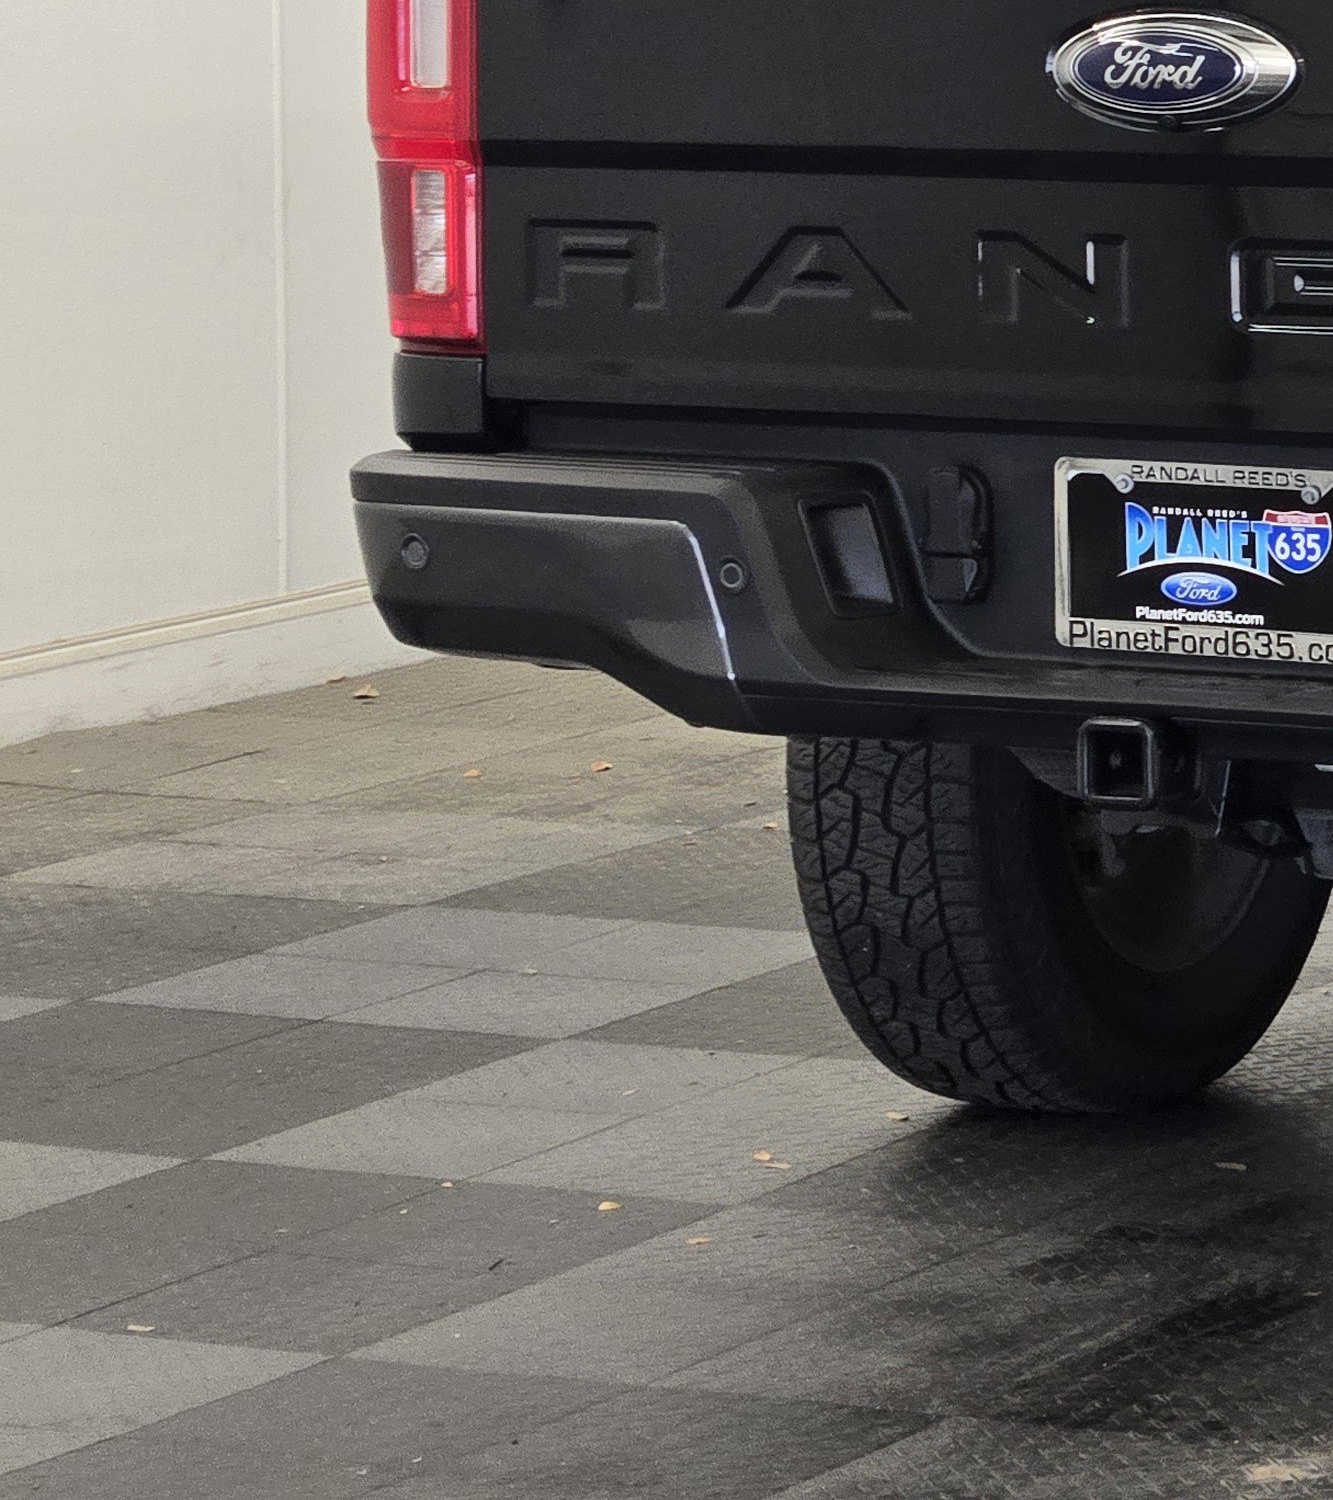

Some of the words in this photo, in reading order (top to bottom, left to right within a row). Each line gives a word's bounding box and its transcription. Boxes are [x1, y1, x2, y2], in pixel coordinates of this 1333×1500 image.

[1104, 38, 1207, 90] Ford
[1130, 464, 1226, 485] RANDALL
[1233, 471, 1307, 488] REED'S
[1152, 506, 1203, 517] RANDALL
[1125, 501, 1274, 576] PLANET
[1275, 533, 1321, 562] 635
[1175, 578, 1222, 602] Ford
[1136, 606, 1265, 626] PlanetFord635.com
